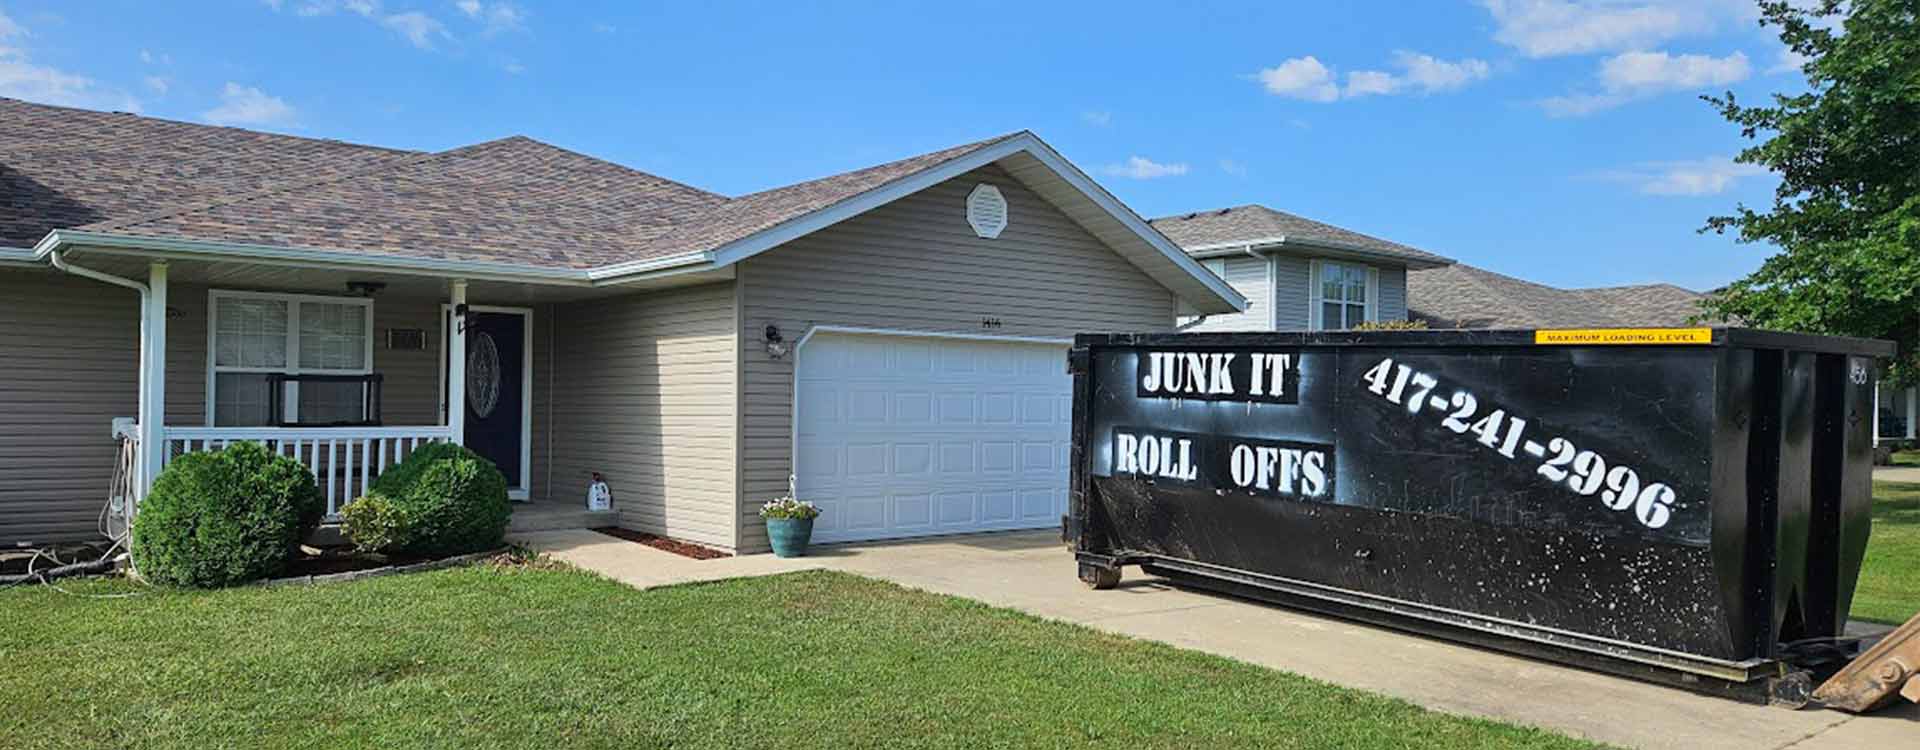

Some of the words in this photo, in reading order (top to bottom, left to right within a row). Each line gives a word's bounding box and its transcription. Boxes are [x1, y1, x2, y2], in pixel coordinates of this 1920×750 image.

[1603, 334, 1655, 342] LOADING
[1658, 334, 1697, 342] LEVEL
[1143, 352, 1236, 395] JUNK
[1249, 352, 1291, 397] IT
[1117, 433, 1198, 480] ROLL
[1230, 444, 1326, 496] OFFS
[1363, 357, 1676, 529] 417-241-2996
